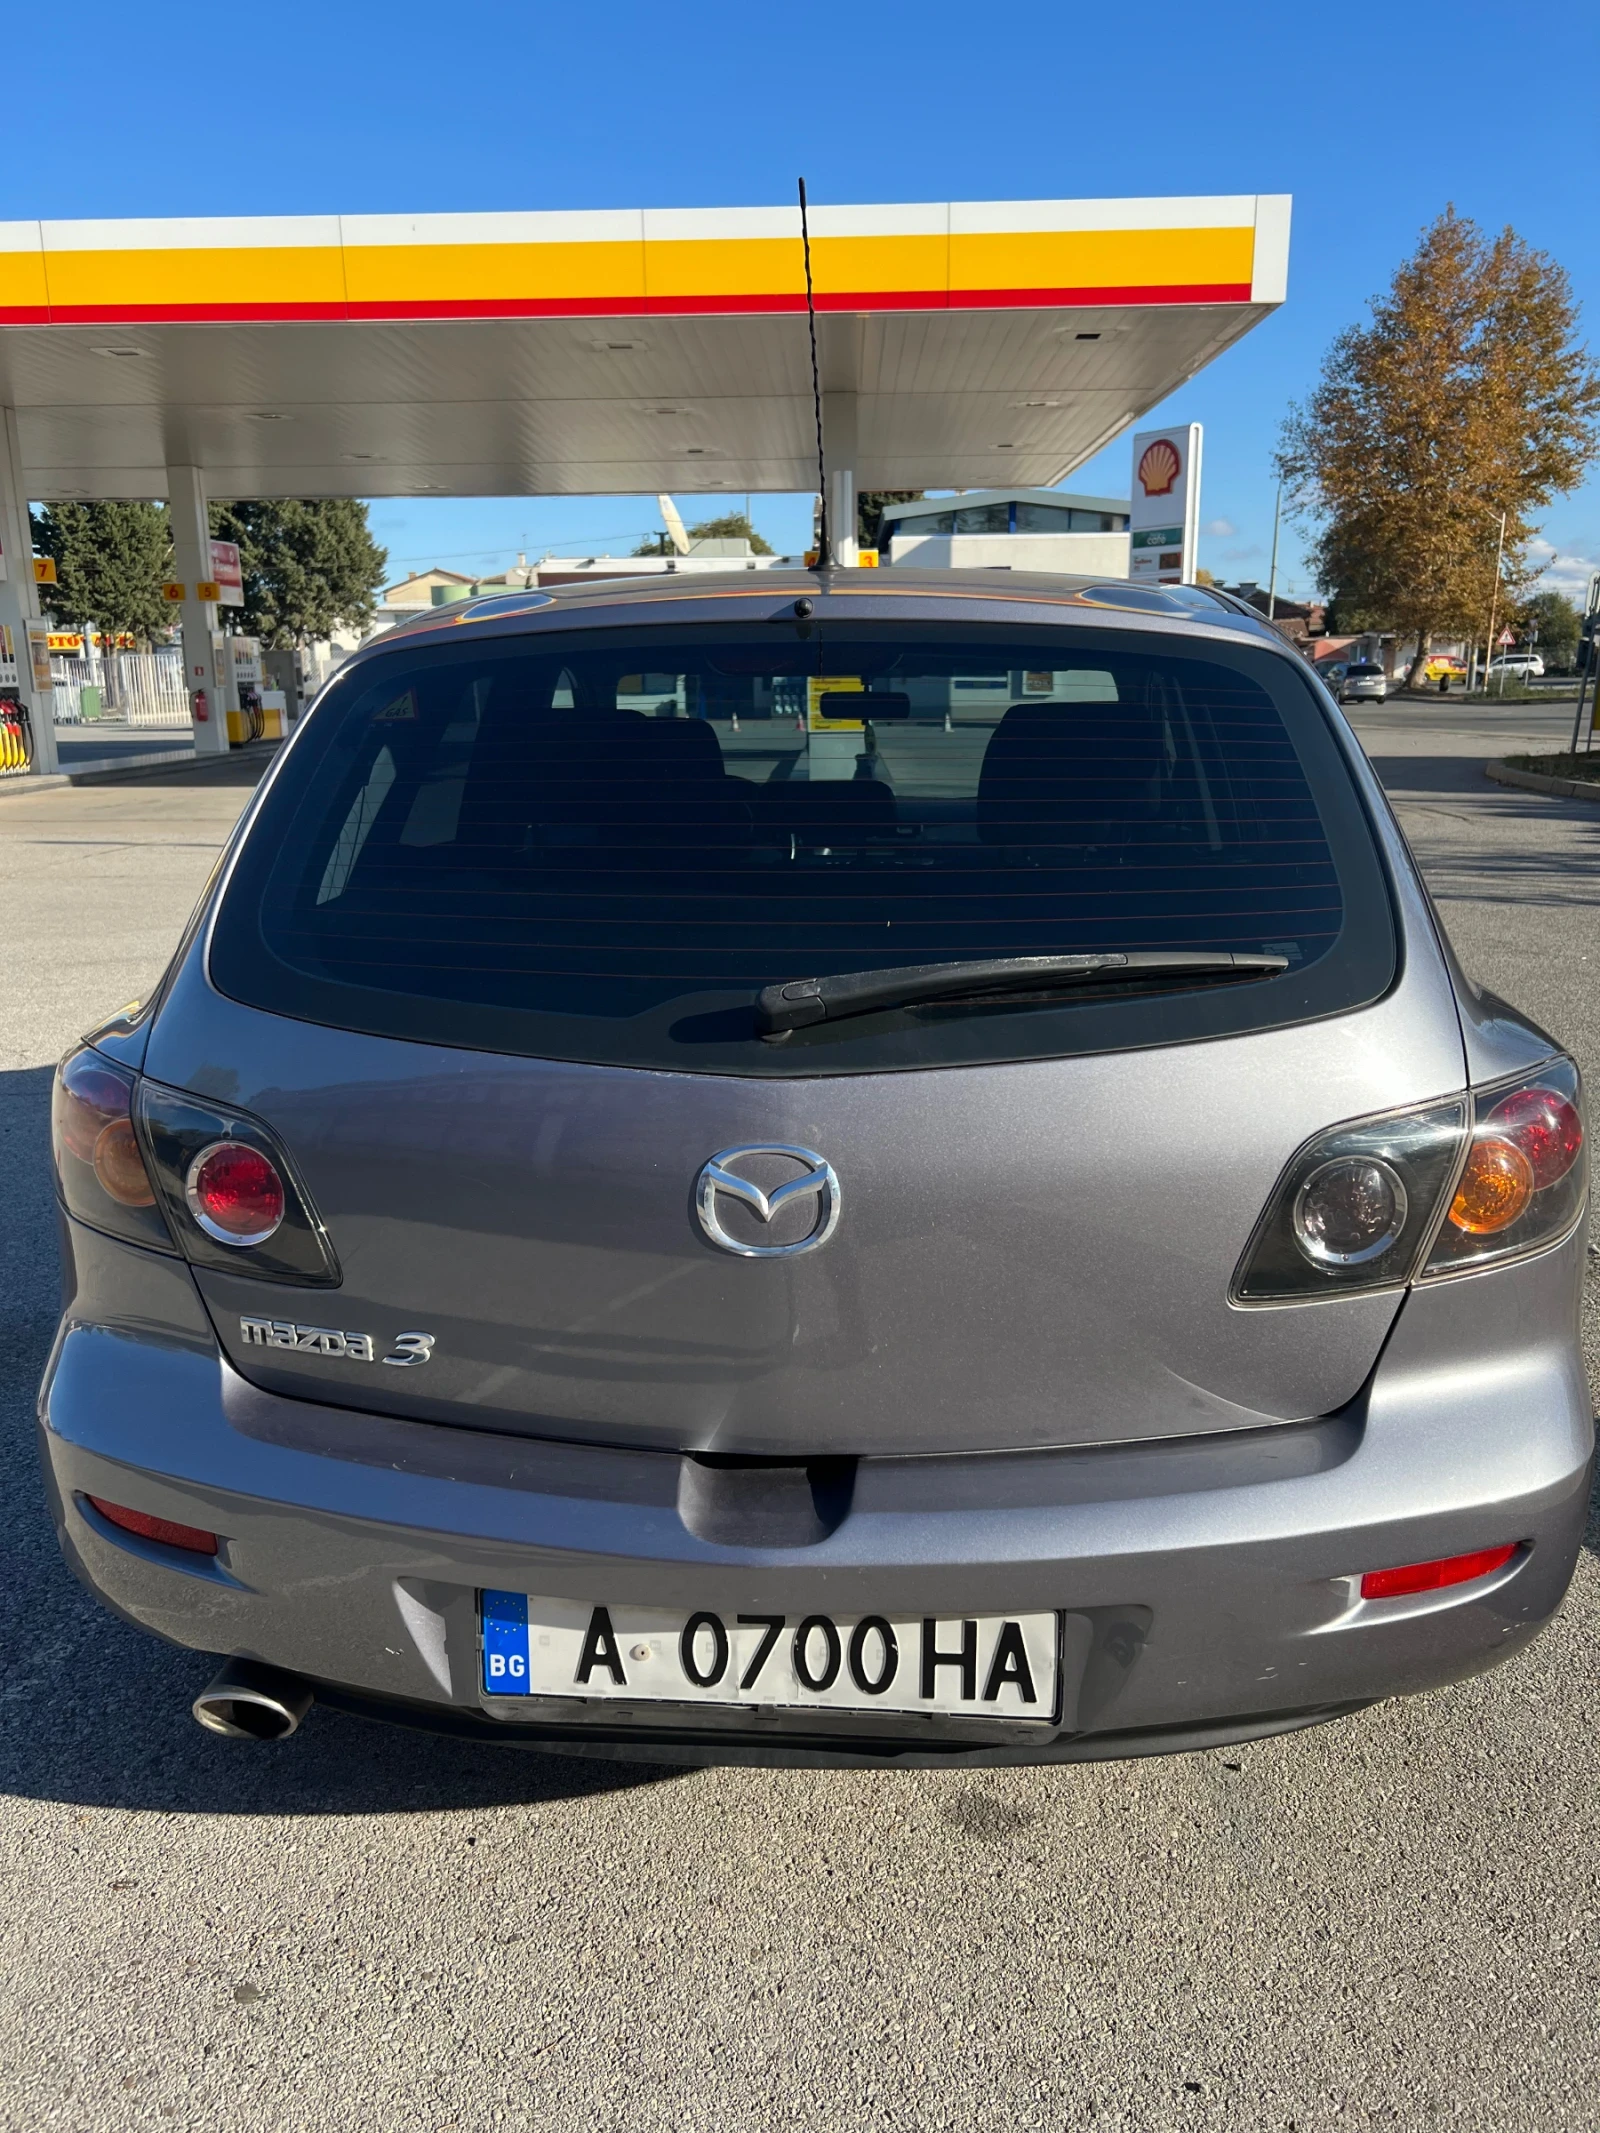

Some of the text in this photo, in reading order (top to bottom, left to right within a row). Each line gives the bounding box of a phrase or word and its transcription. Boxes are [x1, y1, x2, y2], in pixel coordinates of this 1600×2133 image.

[37, 564, 47, 577] 7
[169, 585, 179, 599] 6
[204, 586, 212, 598] 5
[386, 708, 408, 717] GAS
[382, 1331, 436, 1367] 3
[573, 1606, 1038, 1704] A 0700 HA
[489, 1654, 525, 1678] BG
